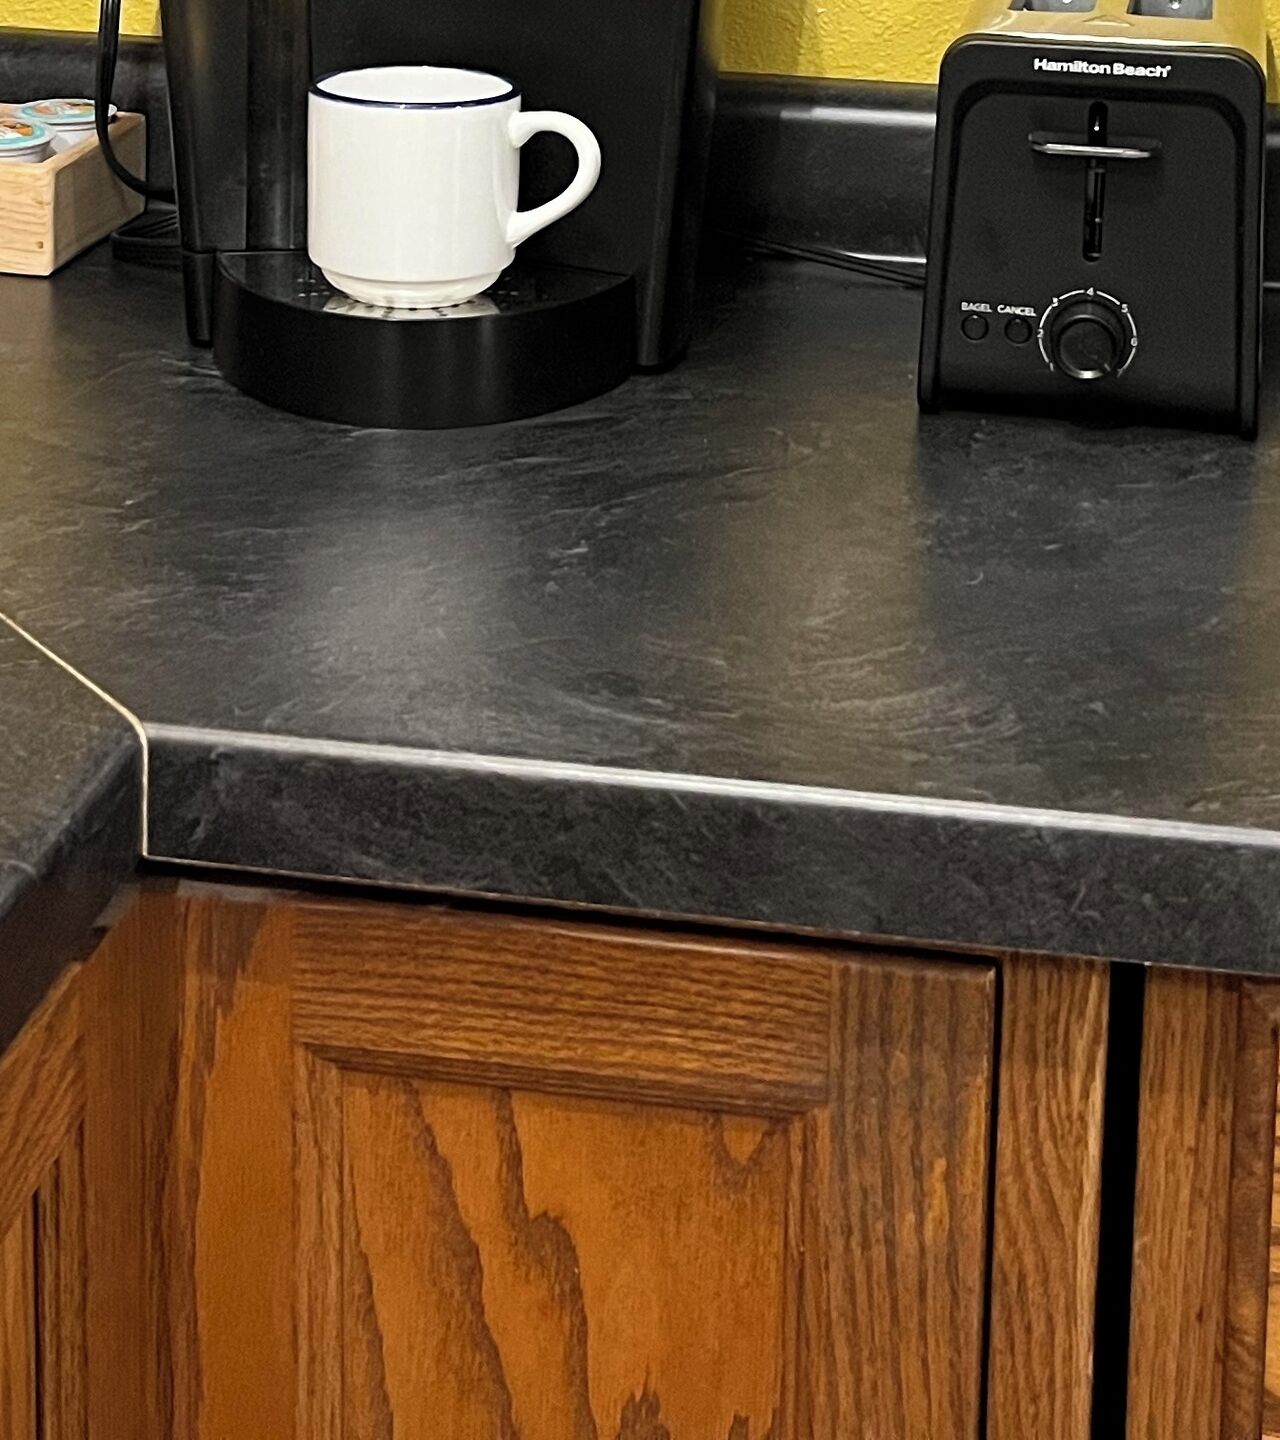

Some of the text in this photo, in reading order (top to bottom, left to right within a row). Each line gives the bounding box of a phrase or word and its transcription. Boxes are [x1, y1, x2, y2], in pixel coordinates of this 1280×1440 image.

[1033, 58, 1111, 75] Hamilton
[1086, 287, 1095, 296] 4
[961, 301, 993, 313] BAGEL
[1051, 297, 1059, 307] 3
[997, 304, 1037, 317] CANCEL
[1121, 304, 1129, 313] 5
[1037, 329, 1044, 338] 2
[1130, 337, 1138, 347] 6
